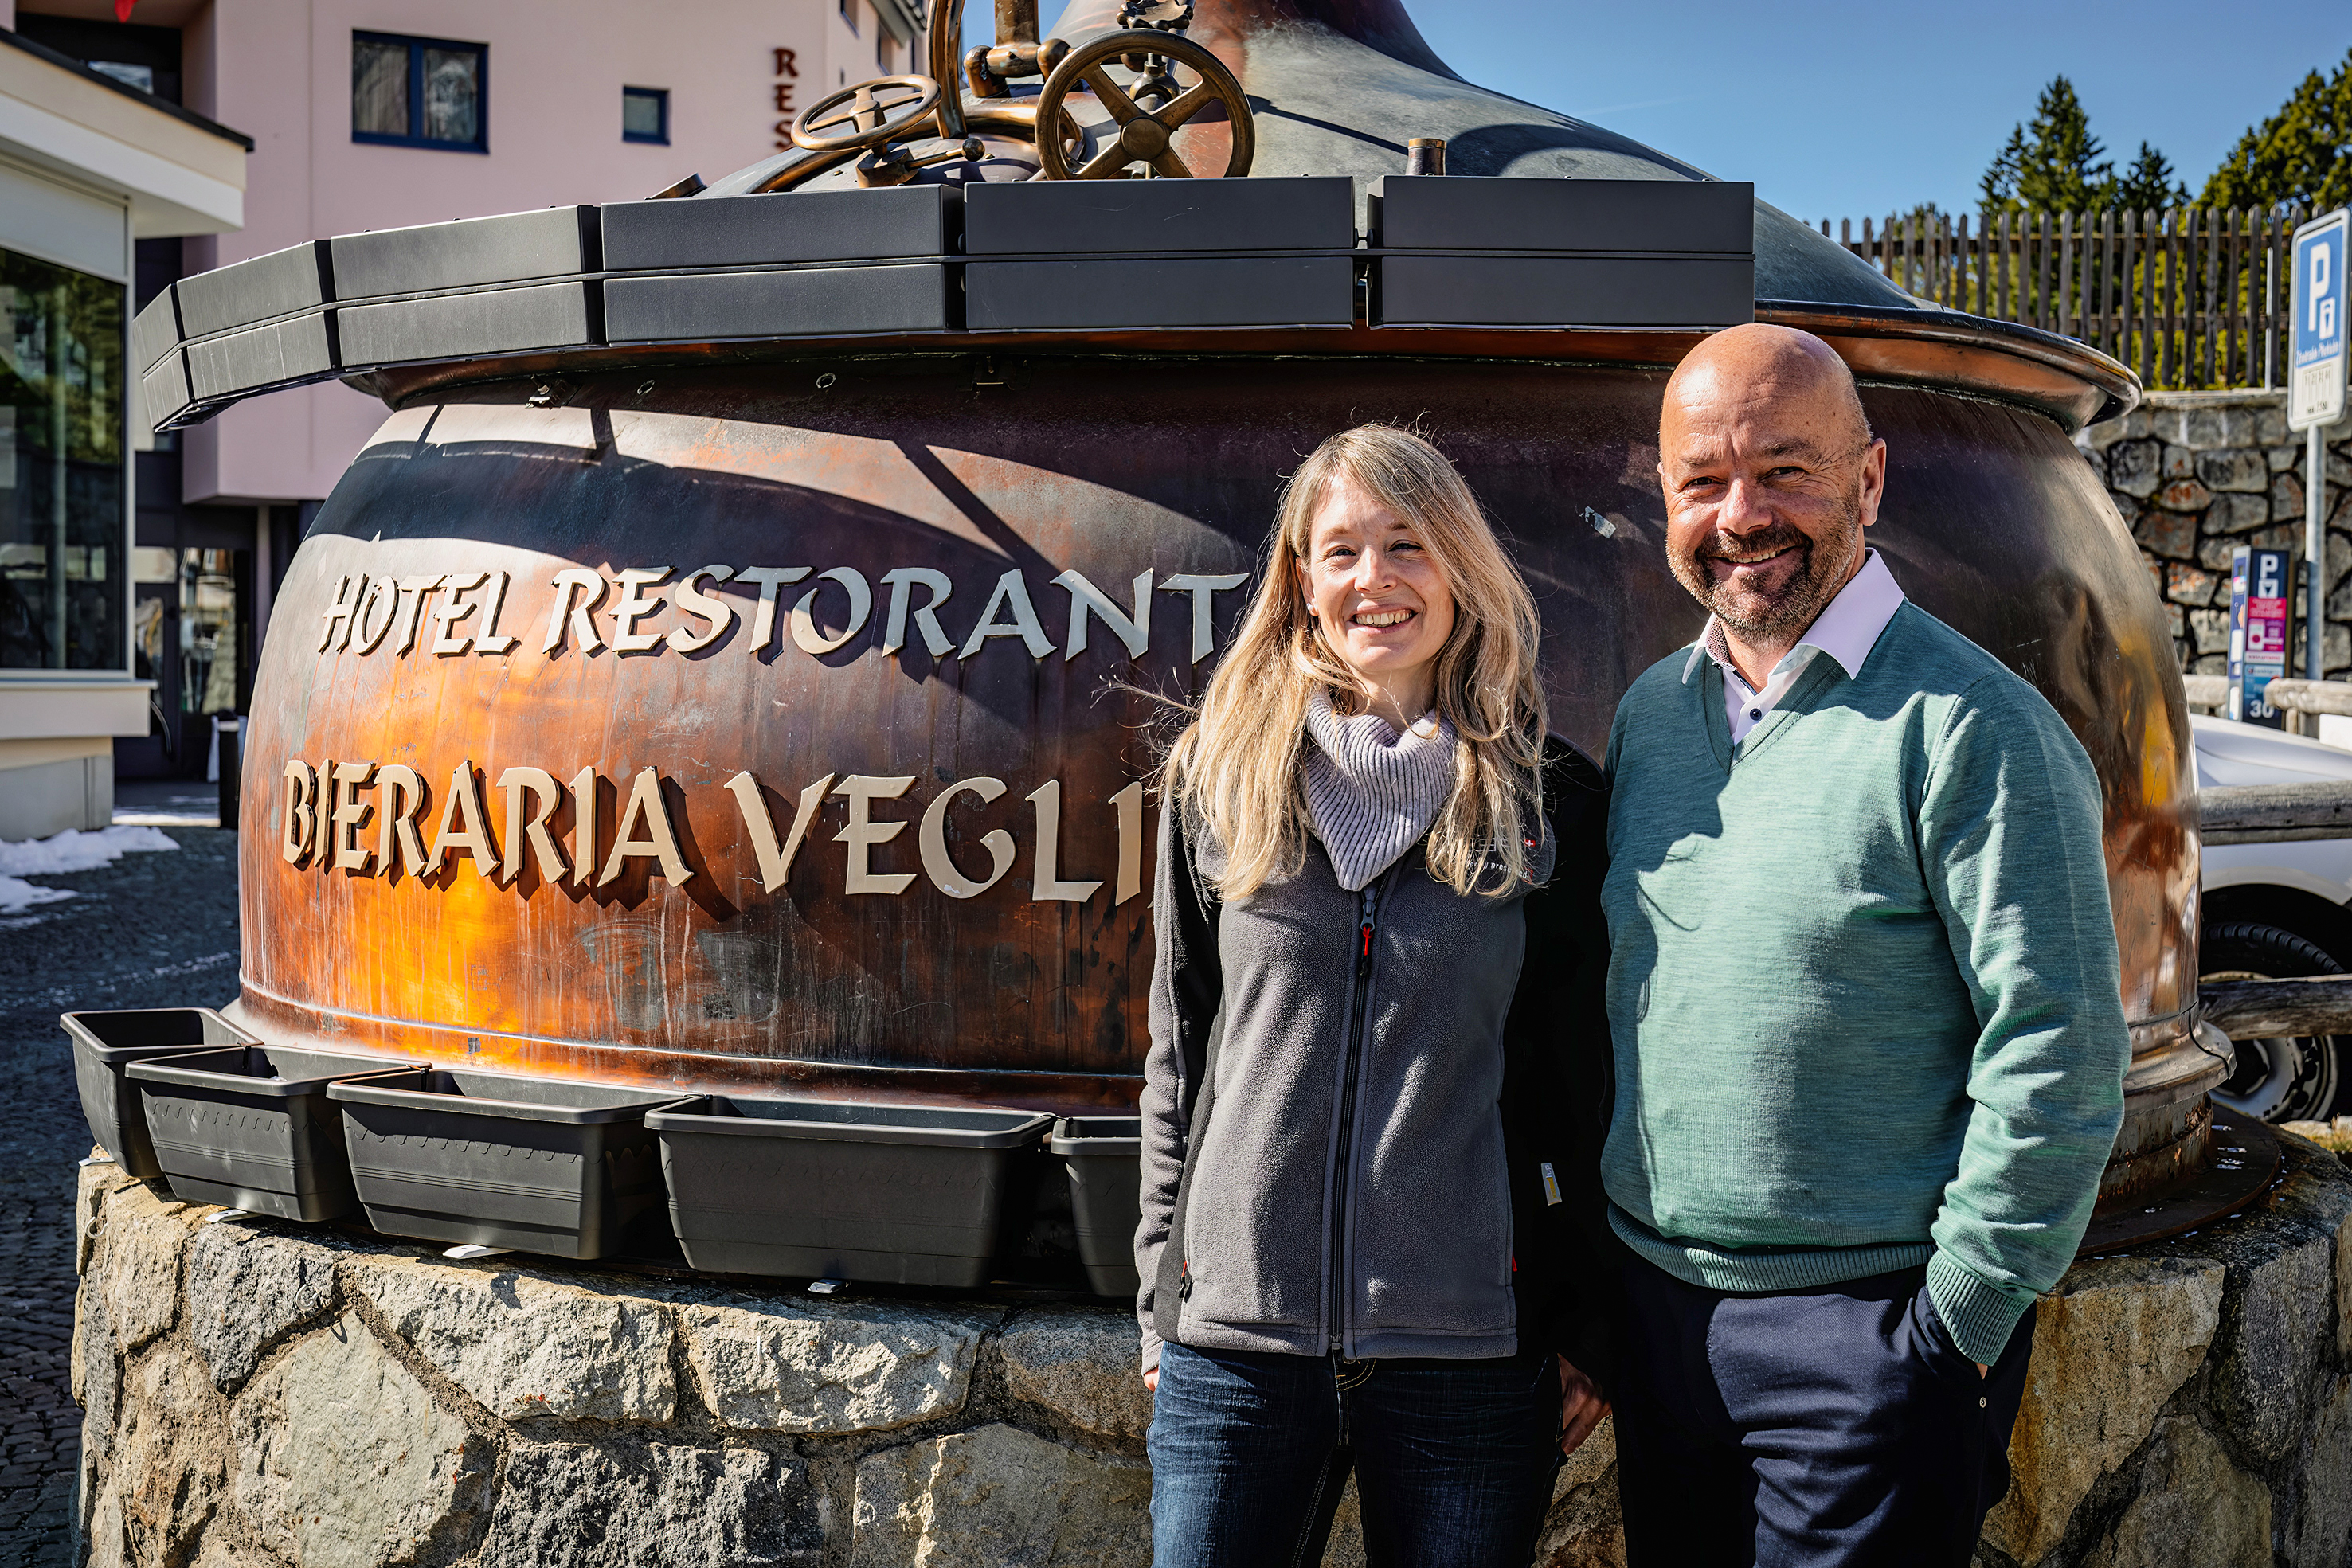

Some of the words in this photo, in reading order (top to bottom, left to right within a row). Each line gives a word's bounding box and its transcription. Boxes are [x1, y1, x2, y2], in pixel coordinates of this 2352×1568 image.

[2308, 241, 2330, 332] P
[2260, 553, 2279, 579] P
[318, 570, 519, 656] HOTEL
[542, 564, 1250, 665] RESTORANT
[283, 757, 695, 889] BIERARIA
[723, 770, 1153, 909] VEGLI
